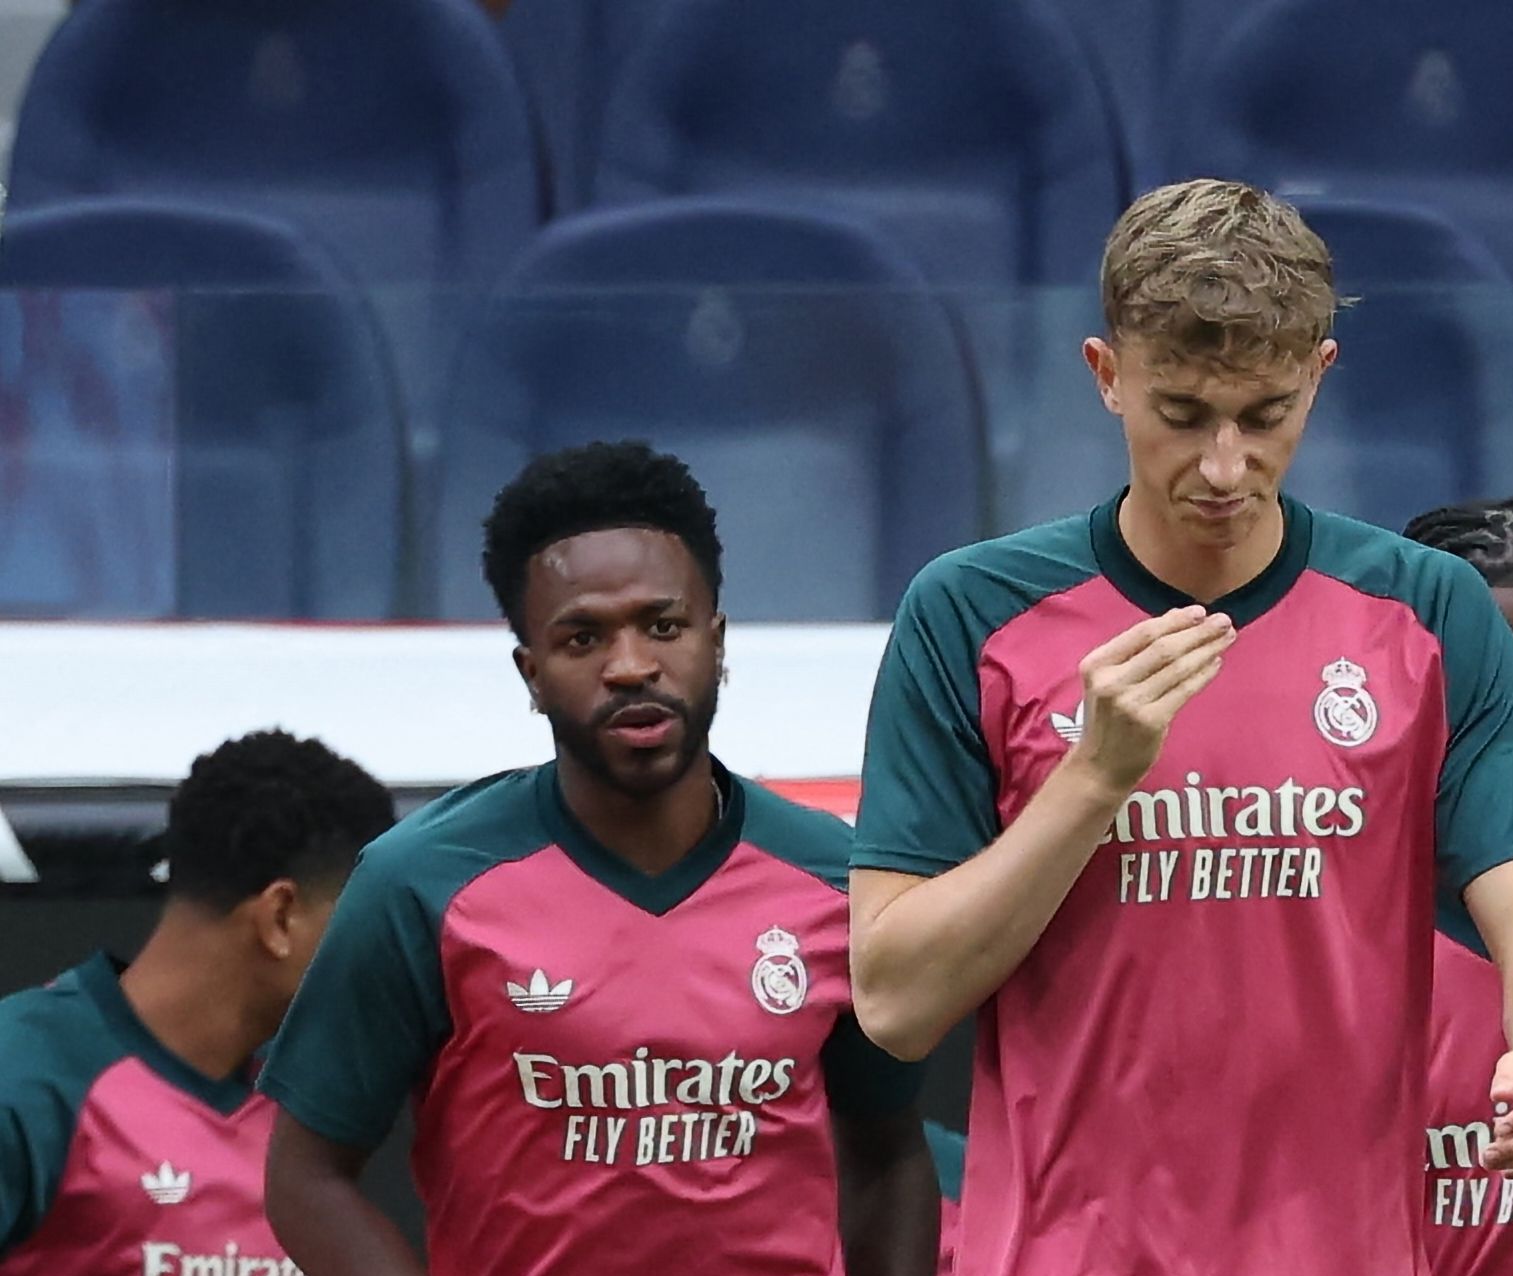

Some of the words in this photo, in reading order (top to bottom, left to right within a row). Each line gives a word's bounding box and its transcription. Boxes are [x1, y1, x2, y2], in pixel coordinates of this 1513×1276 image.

[1099, 771, 1365, 846] mirates
[1120, 850, 1179, 903] FLY
[1190, 847, 1322, 901] BETTER
[512, 1046, 796, 1110] Emirates
[564, 1115, 628, 1165] FLY
[636, 1110, 757, 1167] BETTER
[1435, 1177, 1489, 1228] FLY
